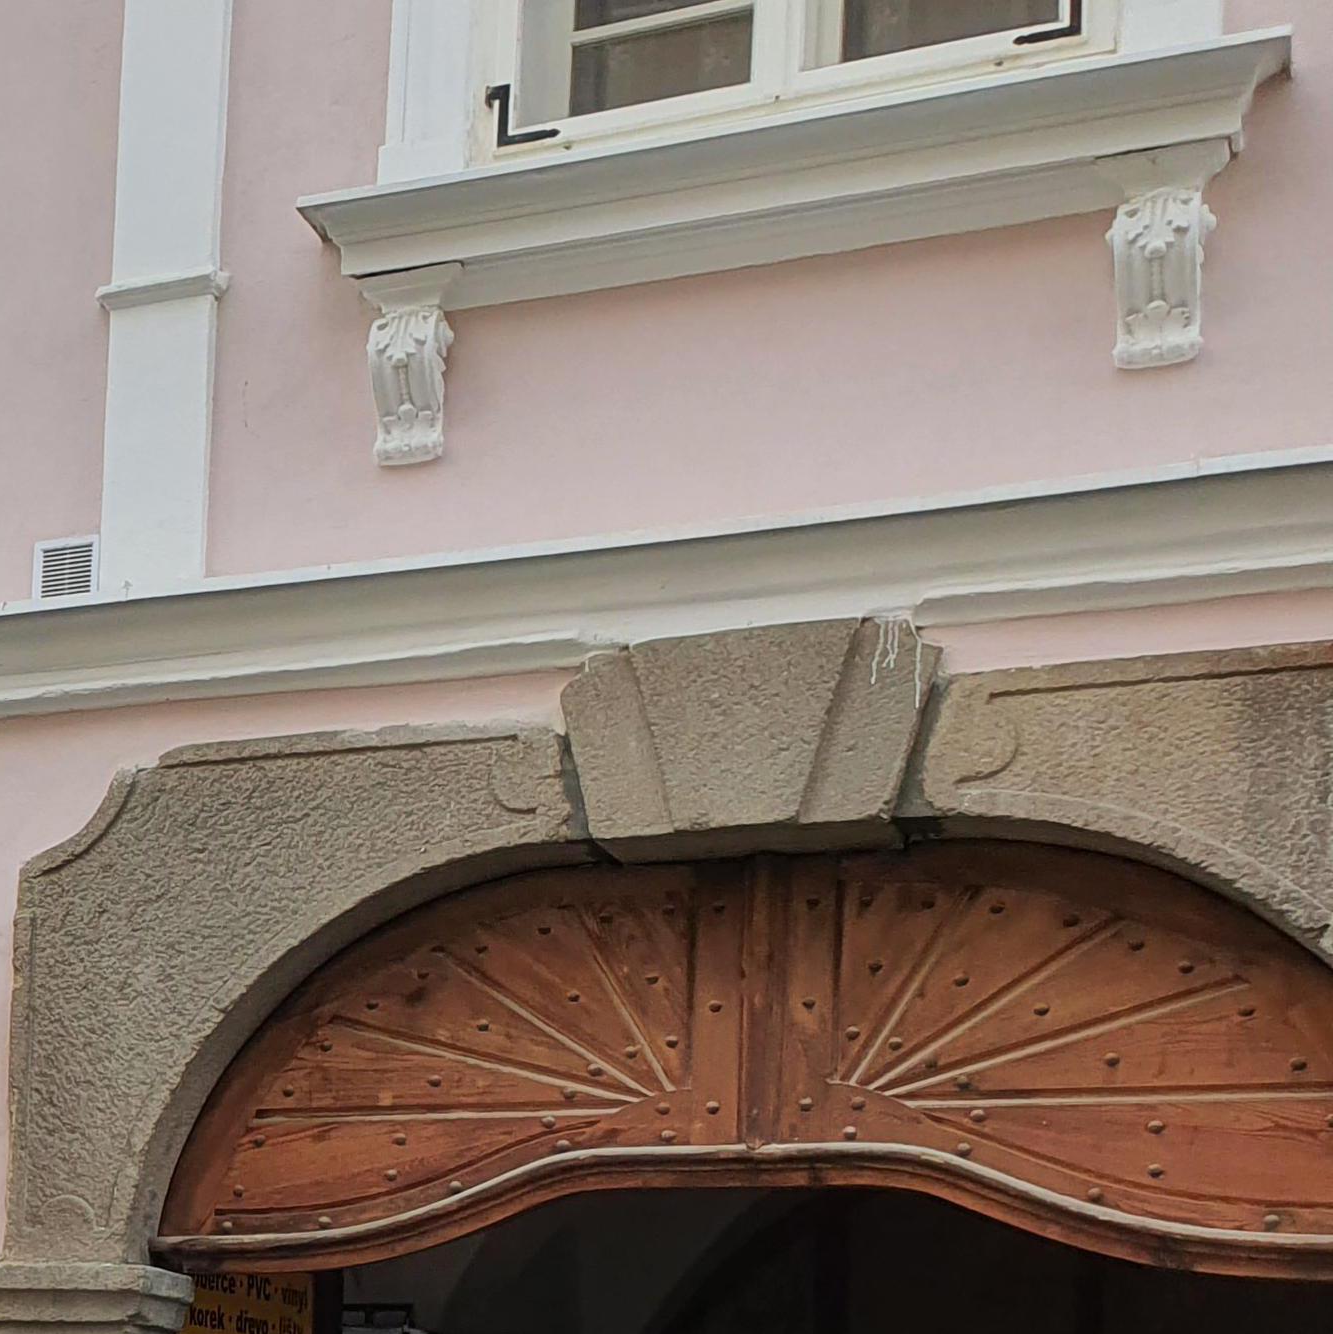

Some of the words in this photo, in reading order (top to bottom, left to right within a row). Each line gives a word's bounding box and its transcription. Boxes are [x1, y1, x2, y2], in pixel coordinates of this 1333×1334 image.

[194, 1273, 237, 1295] berce
[247, 1275, 271, 1301] PVC
[189, 1304, 225, 1330] korek
